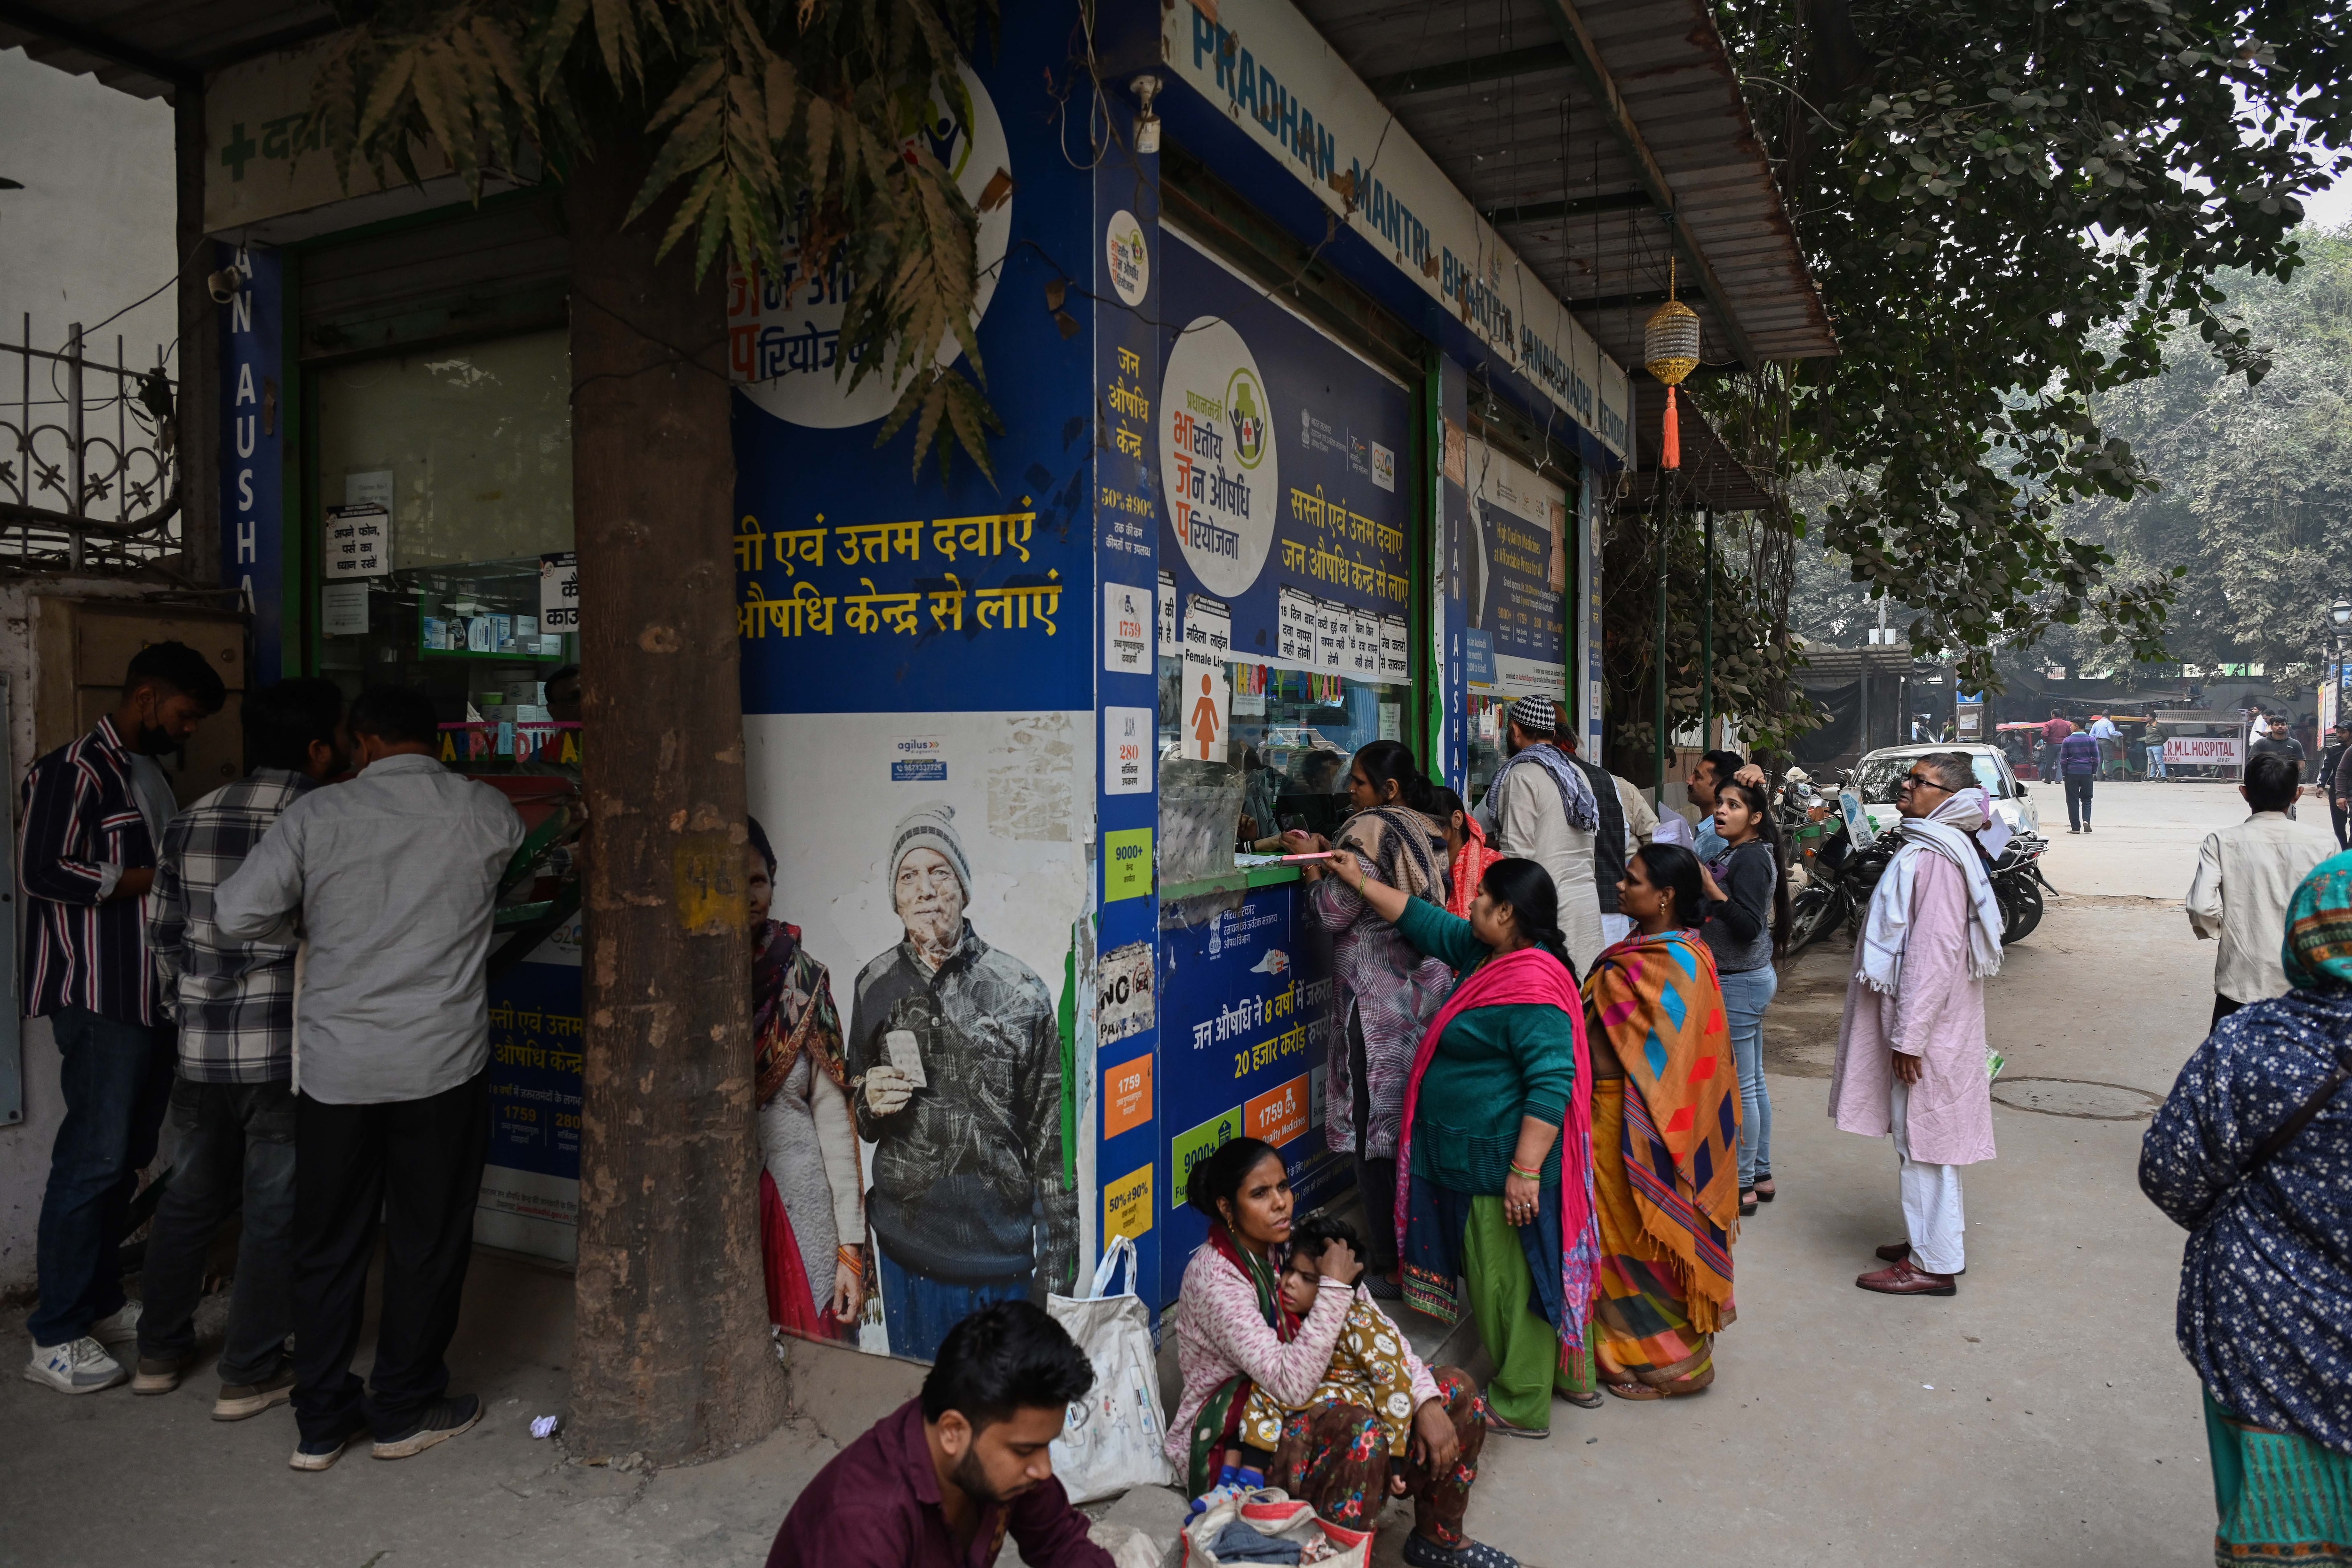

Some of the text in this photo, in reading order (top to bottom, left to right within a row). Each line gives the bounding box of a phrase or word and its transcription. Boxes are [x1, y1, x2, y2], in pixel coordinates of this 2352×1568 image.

[1192, 4, 1335, 189] PRADHAN
[1353, 157, 1430, 272] MANTRI
[1118, 346, 1139, 378] जन
[1108, 376, 1149, 423] औषधि
[1186, 390, 1223, 424] प्रधानमंत्री
[1116, 420, 1142, 460] केन्द्र
[1174, 410, 1223, 463] भारतीय
[1174, 452, 1251, 520] जन औषधि
[1126, 493, 1133, 513] से
[1134, 496, 1154, 519] 90%
[334, 525, 354, 539] अपने
[774, 512, 828, 577] एवं
[835, 520, 925, 565] उत्तम
[932, 495, 1037, 563] दवाएं
[1114, 522, 1143, 539] तक की कम
[1176, 501, 1239, 560] परियोजना
[1290, 484, 1403, 562] सस्ती एवं उत्तम दवाएं
[342, 541, 372, 554] पर्स का
[1105, 534, 1151, 557] कीमतों पर उपलब्ध
[1497, 522, 1540, 555] High Quality Medicines
[337, 559, 356, 570] ध्यान
[1282, 535, 1409, 610] जन औषधि केन्द्र से लाएं
[1494, 547, 1499, 563] at
[1499, 548, 1520, 570] Affordable
[1521, 556, 1532, 574] Prices
[844, 578, 922, 636] केन्द्र
[929, 573, 967, 633] से
[975, 567, 1064, 637] लाएं
[1280, 604, 1315, 627] 15 दिन बाद
[1318, 616, 1328, 630] कटी
[1340, 623, 1348, 634] दवा
[1355, 620, 1365, 635] बिना
[1517, 612, 1527, 625] 1759
[1119, 621, 1141, 638] 1759
[1186, 623, 1228, 653] महिला लाईन
[1283, 624, 1312, 643] दवा वापस
[1321, 637, 1334, 648] वापस
[1185, 648, 1212, 666] Female
[1283, 639, 1311, 661] नही होगी
[1327, 652, 1339, 665] होगी
[1365, 654, 1374, 669] होगी
[1367, 643, 1378, 654] वापस
[1388, 658, 1406, 672] सावधान
[1237, 662, 1341, 702] HAPPY DIWALI
[436, 731, 499, 764] APPY
[898, 739, 928, 752] agilus
[1120, 745, 1138, 760] 280
[1121, 762, 1138, 774] सर्जिकल
[1121, 777, 1137, 786] उपकरण
[1116, 844, 1143, 860] 9000+
[1224, 933, 1250, 949] औषध विभाग
[1100, 975, 1129, 1010] NO
[517, 1005, 543, 1035] एवं
[546, 1014, 583, 1038] उत्तम
[1192, 1019, 1213, 1050] जन
[1216, 998, 1252, 1042] औषधि
[1254, 994, 1263, 1027] ने
[1264, 999, 1272, 1024] 8
[1275, 979, 1295, 1019] वर्षों
[1295, 979, 1305, 1010] में
[494, 1035, 547, 1069] औषधि
[1234, 1021, 1307, 1079] 20 हजार करोड़
[1118, 1073, 1141, 1094] 1759
[554, 1090, 562, 1103] के
[564, 1095, 582, 1106] लगभ
[1259, 1080, 1327, 1128] 1759 28
[504, 1104, 581, 1130] 1759 280
[1262, 1115, 1306, 1145] Quality Medicines
[1184, 1141, 1216, 1174] 9000+
[1295, 1161, 1303, 1174] लिए
[1109, 1180, 1148, 1213] 50% 90%
